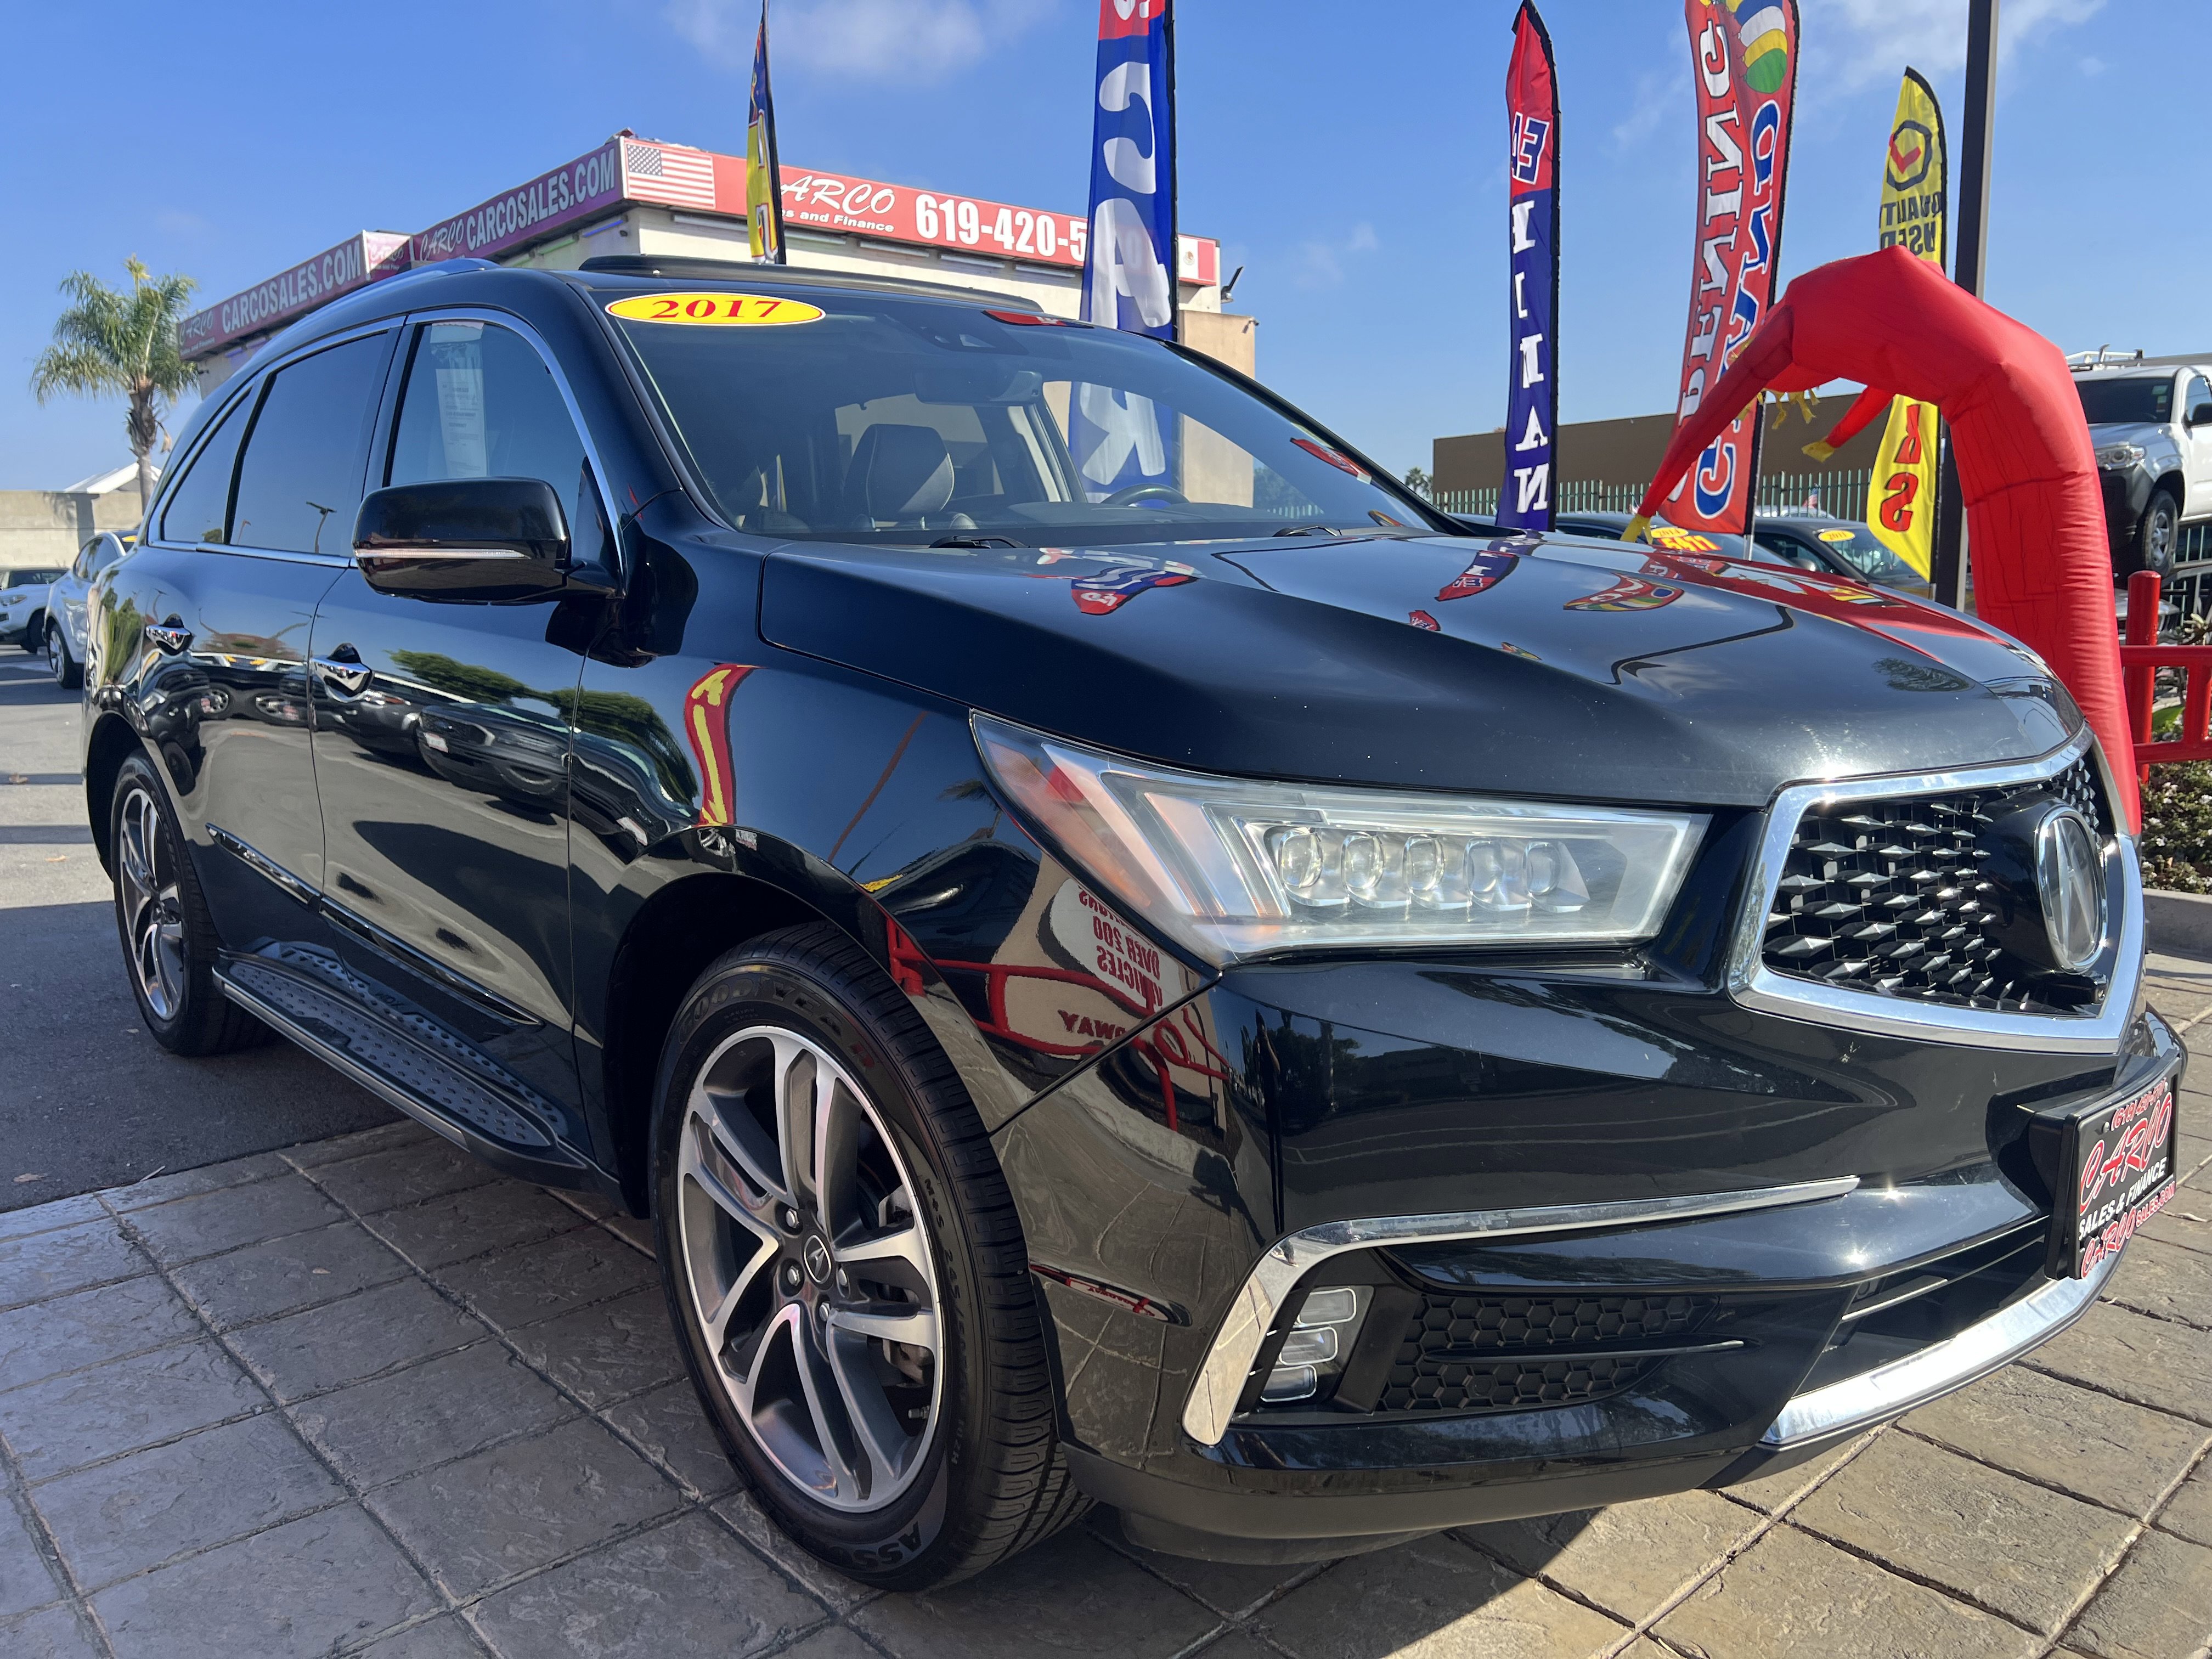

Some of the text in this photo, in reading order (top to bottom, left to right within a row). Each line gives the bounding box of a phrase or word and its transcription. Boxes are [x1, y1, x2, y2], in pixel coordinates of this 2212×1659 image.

[420, 147, 616, 262] CARCO CARCOSALES.COM
[780, 174, 896, 216] ARCO
[799, 210, 830, 223] and
[833, 213, 895, 233] Finance
[222, 240, 361, 334] CARCOSALES.COM
[649, 299, 782, 319] 2017
[2080, 1091, 2172, 1216] CARCO
[2079, 1156, 2167, 1242] SALES & FINANCE
